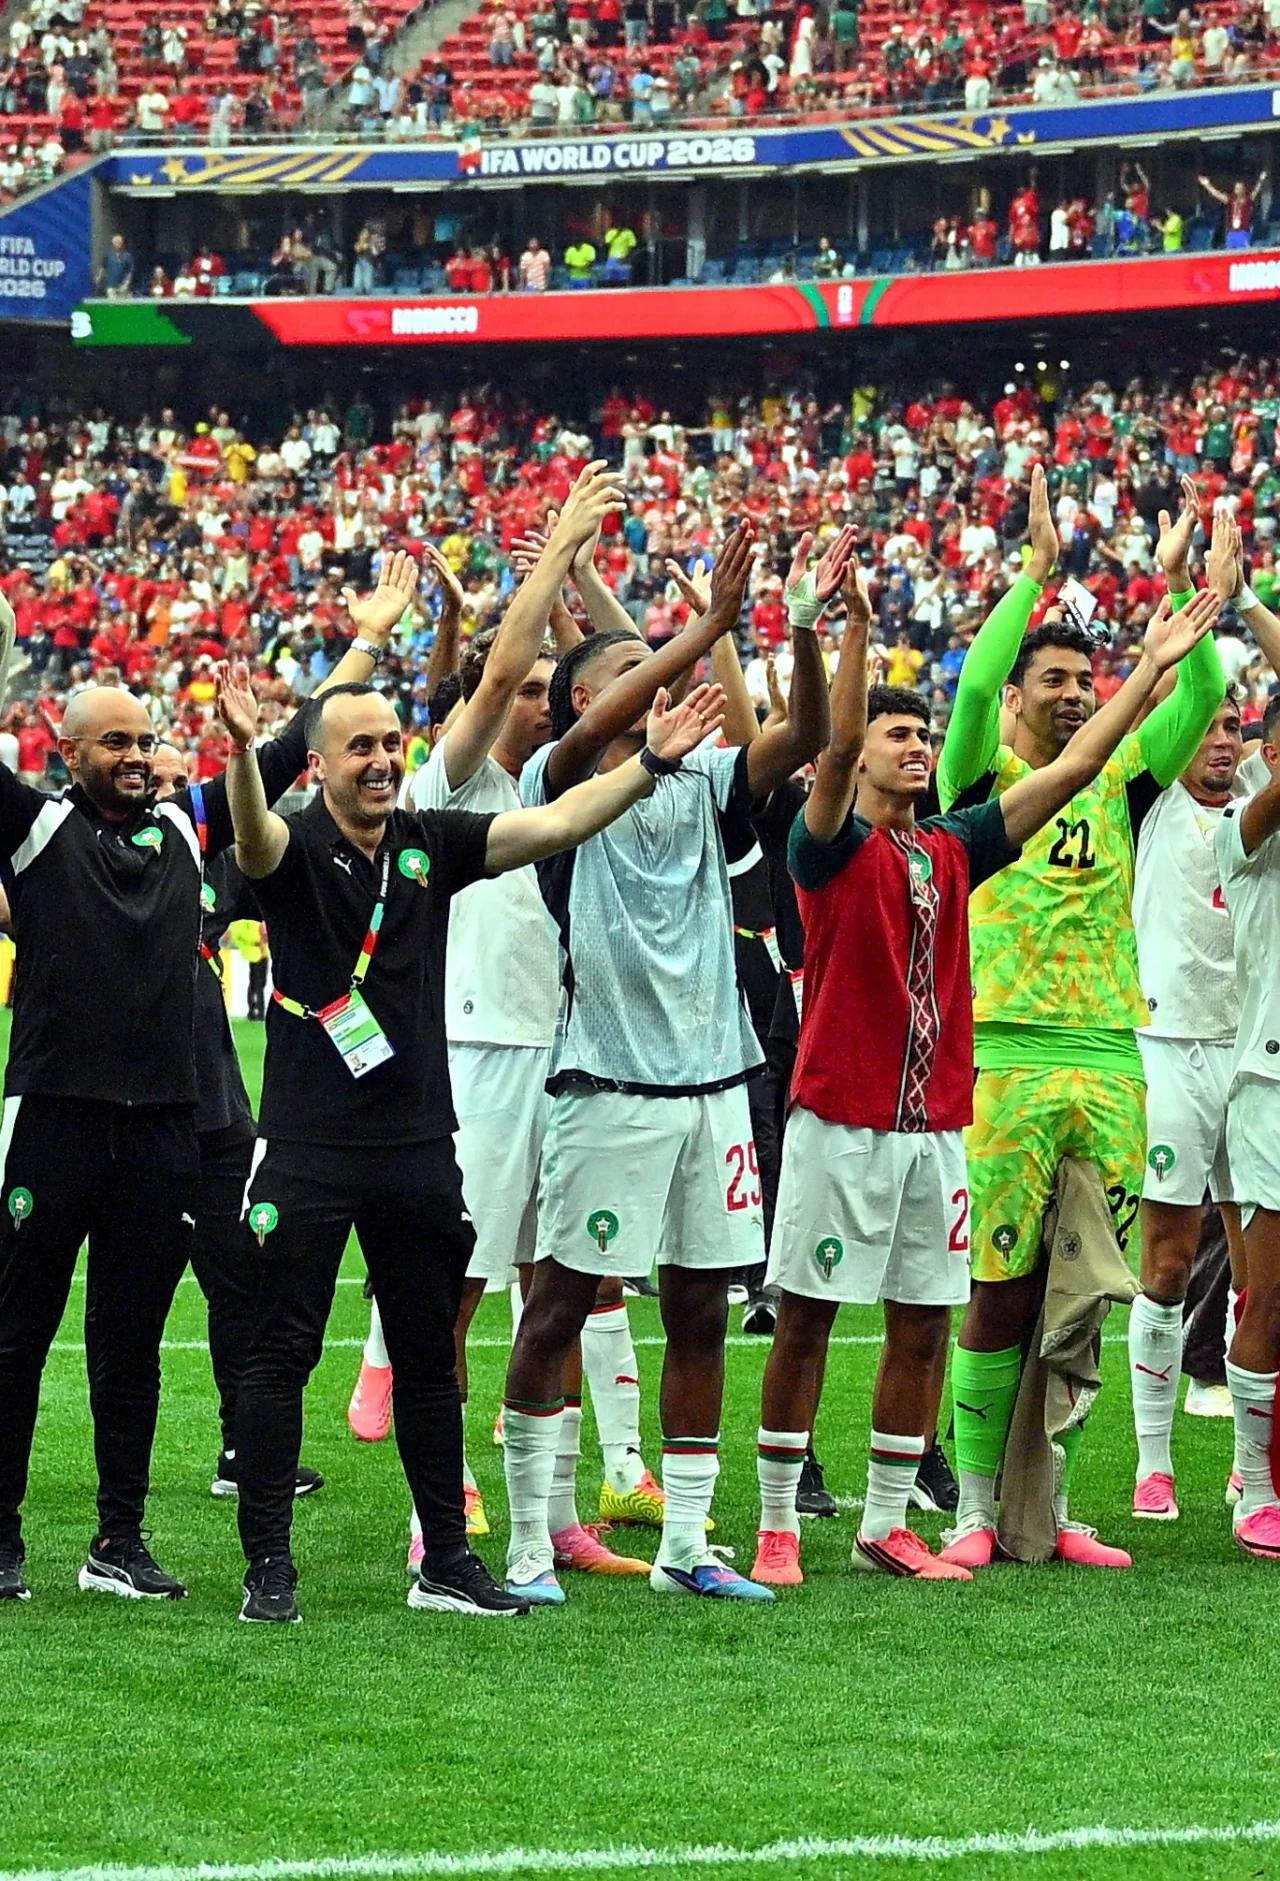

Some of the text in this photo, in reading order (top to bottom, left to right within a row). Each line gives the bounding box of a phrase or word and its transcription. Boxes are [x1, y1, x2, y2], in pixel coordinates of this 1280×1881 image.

[467, 138, 756, 174] IFA WORLD CUP 2026
[1, 236, 35, 255] FIFA
[0, 257, 65, 277] RLD CUP
[0, 278, 46, 298] 026
[1048, 818, 1095, 868] 22
